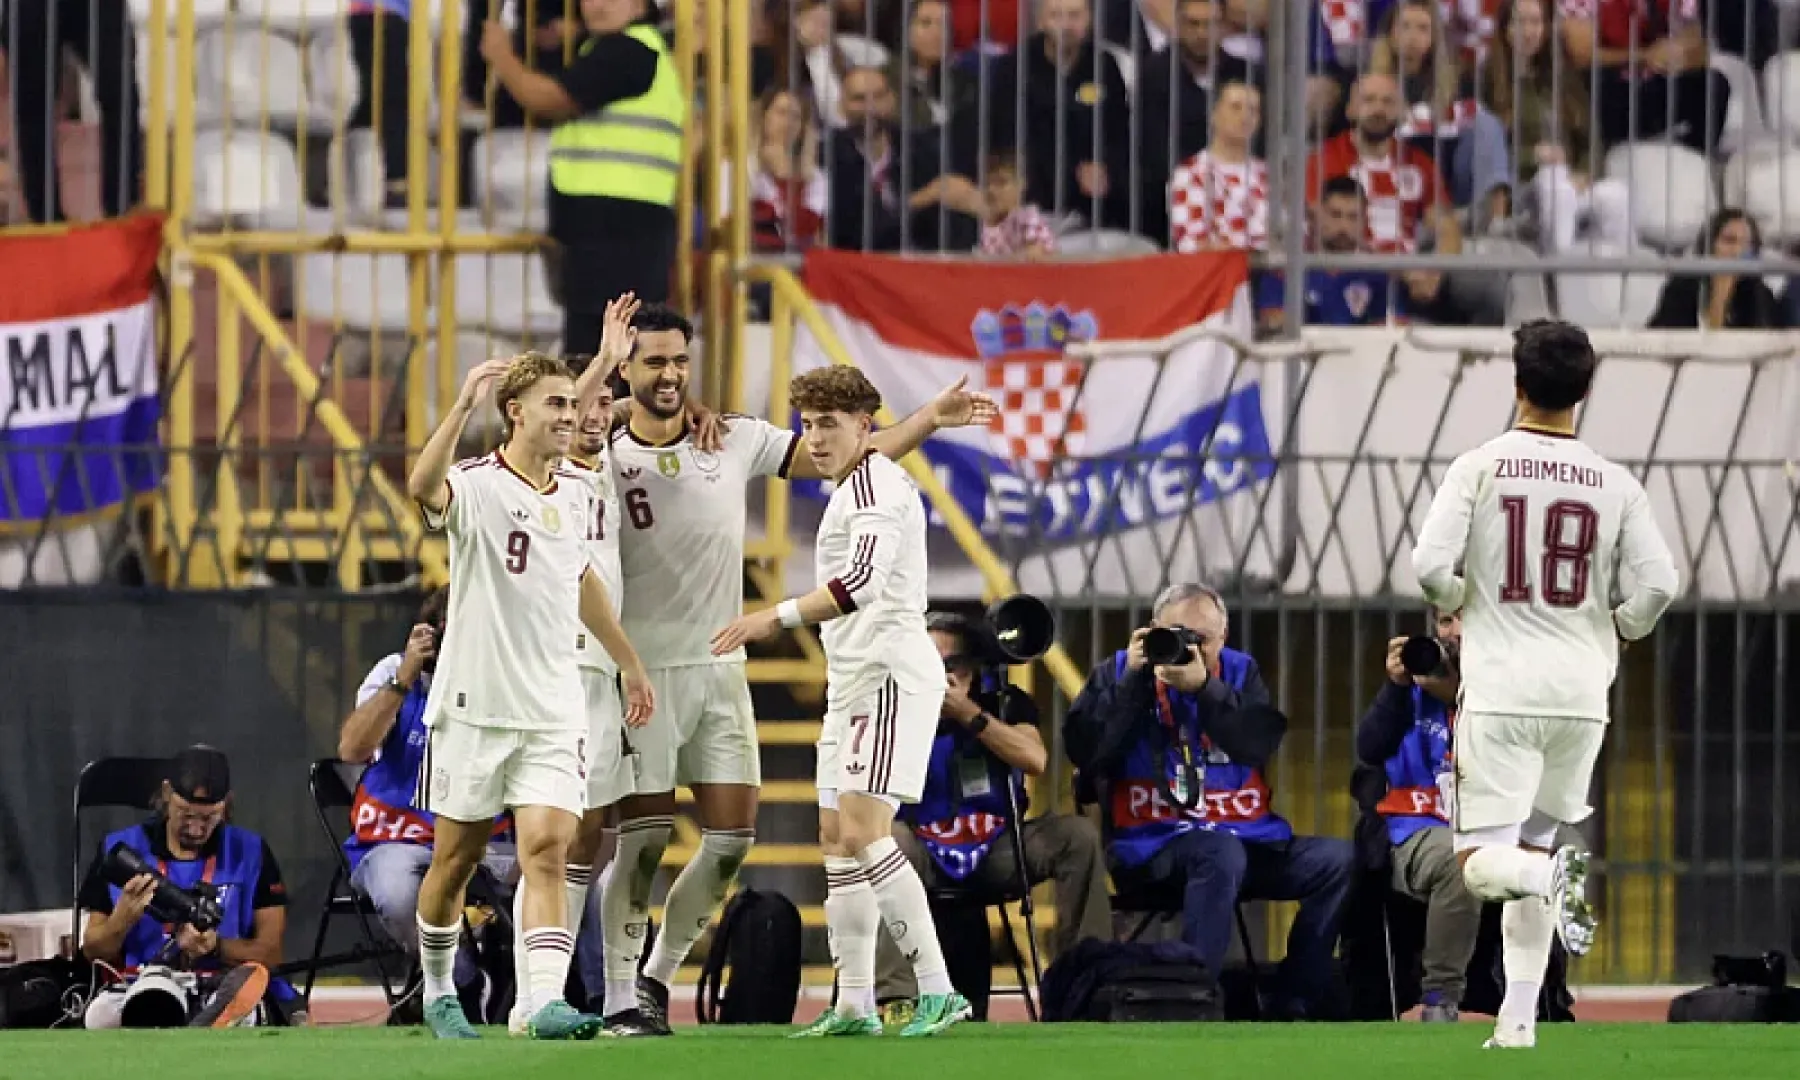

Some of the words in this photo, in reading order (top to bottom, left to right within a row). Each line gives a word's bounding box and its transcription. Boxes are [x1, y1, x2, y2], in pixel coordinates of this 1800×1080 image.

[1494, 458, 1603, 488] ZUBIMENDI
[625, 487, 653, 530] 6
[506, 530, 530, 574] 9
[1498, 494, 1600, 608] 18
[850, 715, 869, 754] 7
